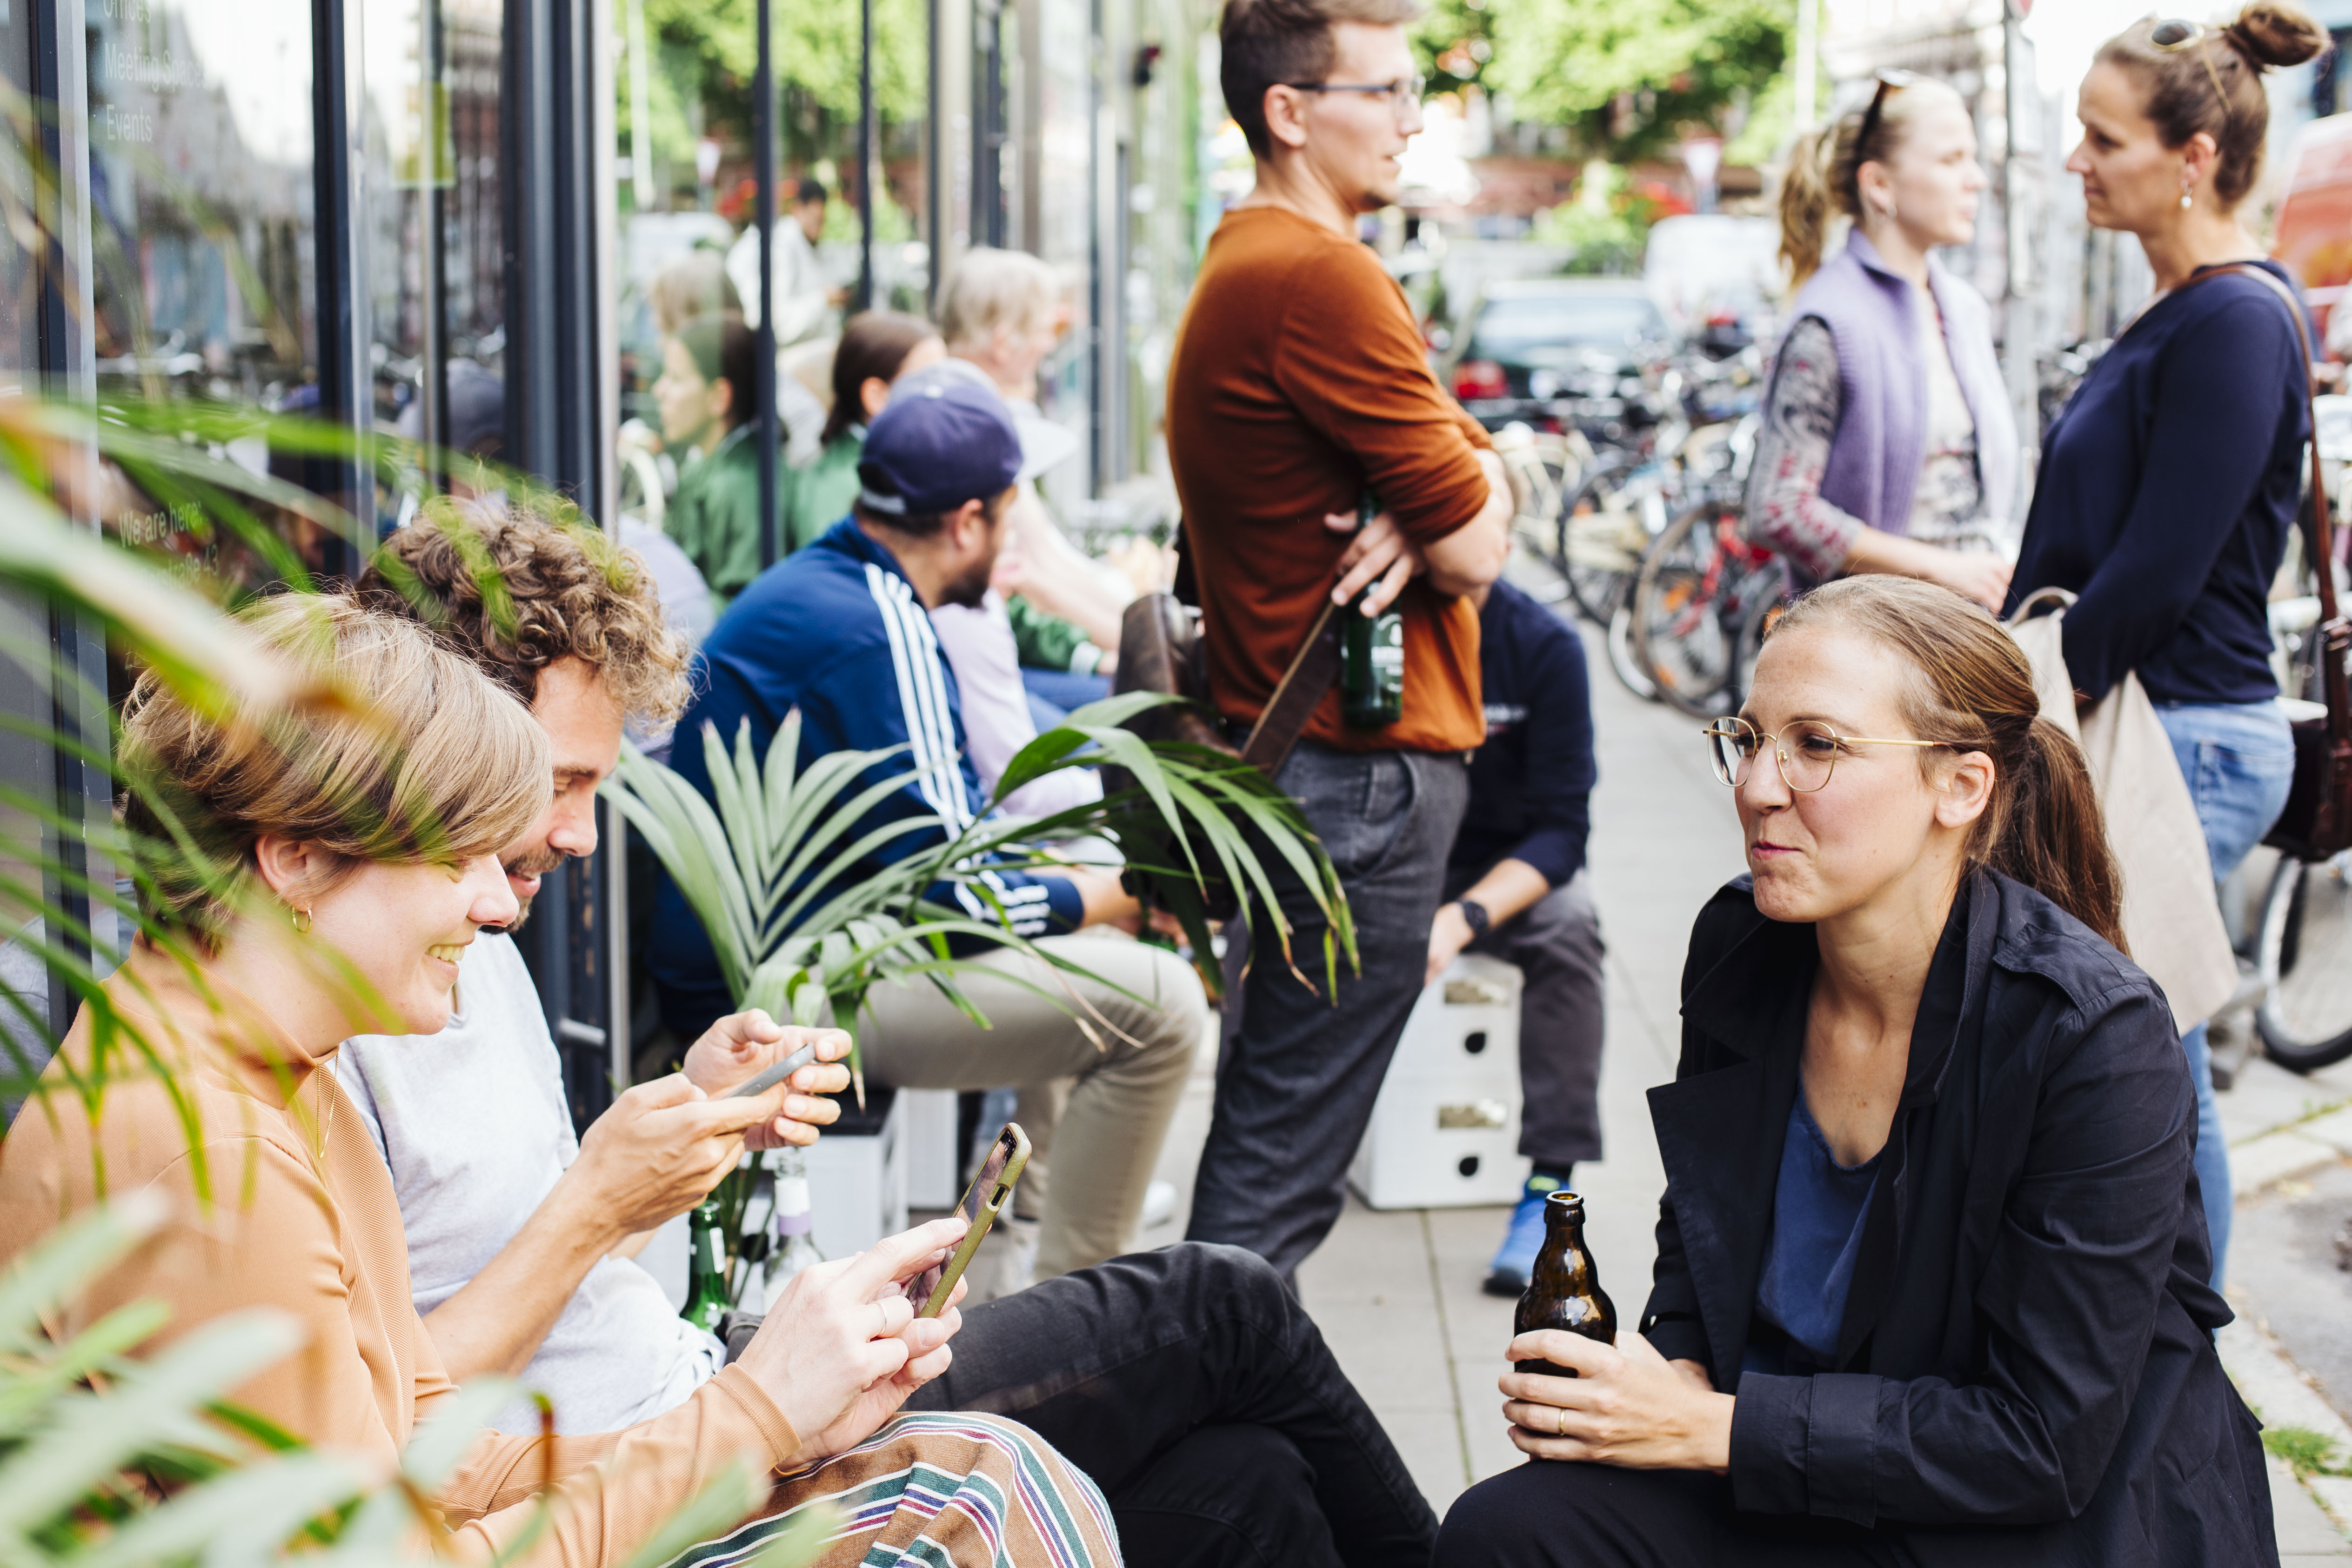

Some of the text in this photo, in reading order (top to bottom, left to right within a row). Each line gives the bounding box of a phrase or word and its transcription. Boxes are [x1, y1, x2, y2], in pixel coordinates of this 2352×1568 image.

[105, 42, 160, 92] Meeting
[107, 104, 152, 141] Events
[119, 510, 140, 548] We
[145, 511, 167, 543] are
